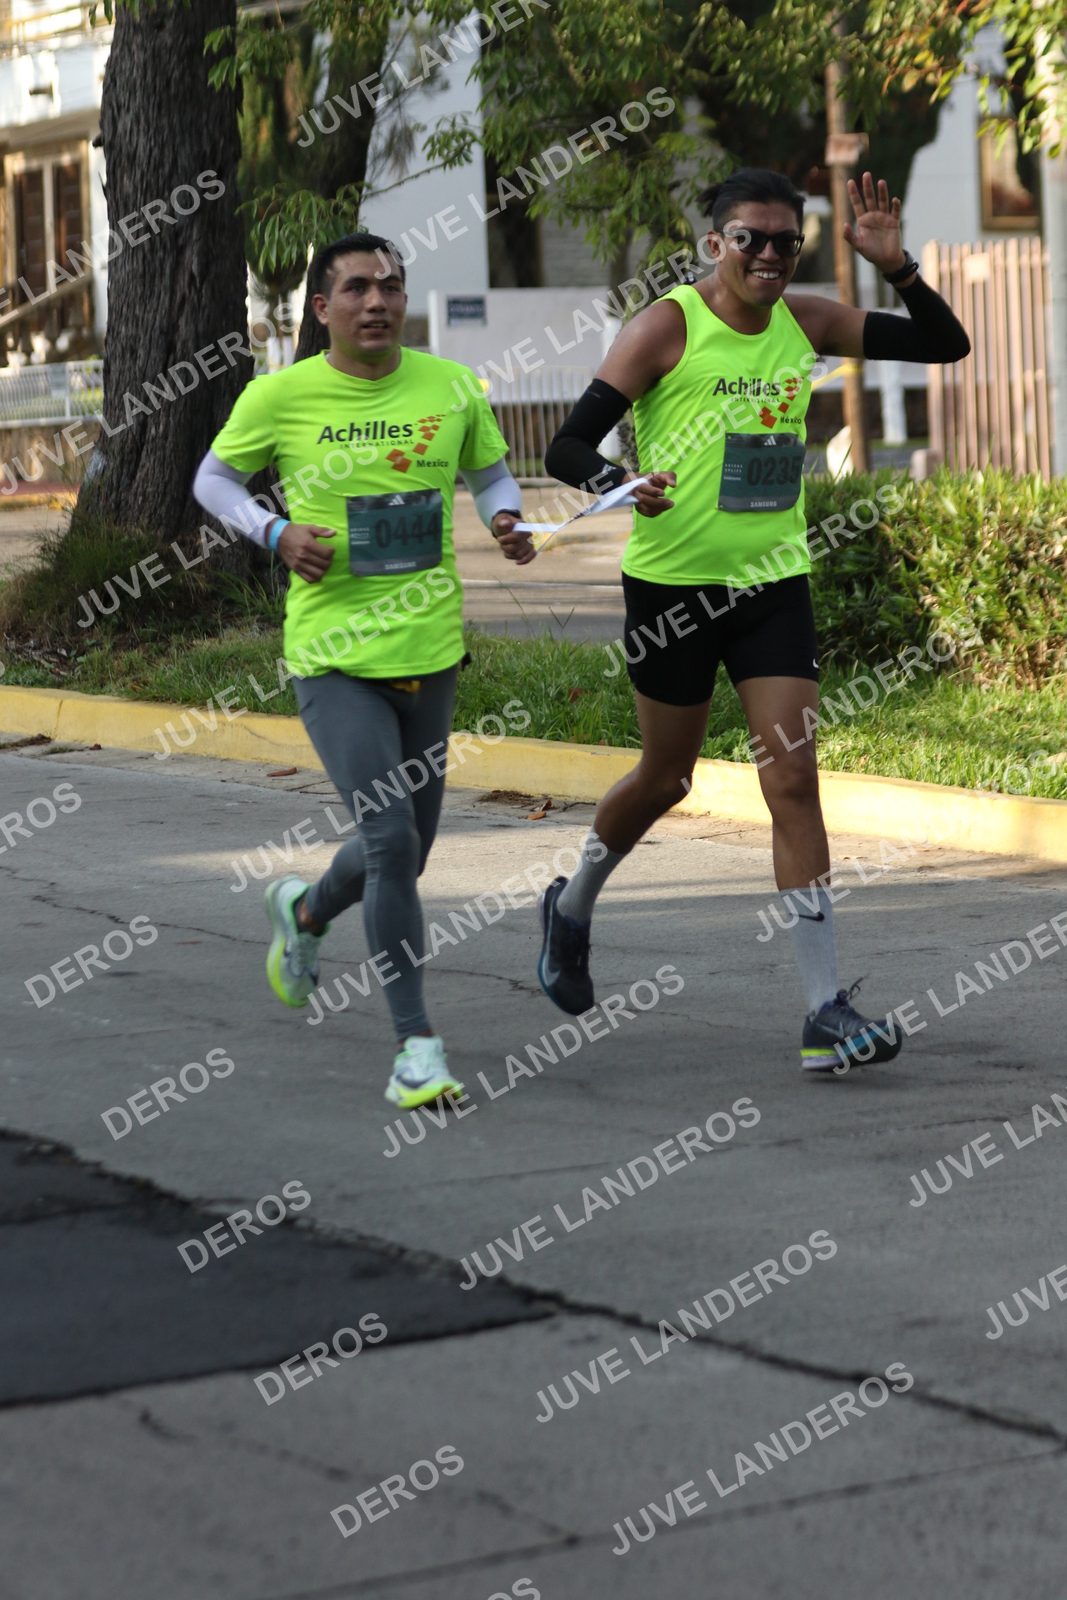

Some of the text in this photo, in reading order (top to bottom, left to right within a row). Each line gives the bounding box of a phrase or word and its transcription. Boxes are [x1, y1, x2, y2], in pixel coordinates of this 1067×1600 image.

[712, 376, 781, 396] Achilles
[316, 420, 414, 444] Achilles
[746, 455, 802, 486] 0235
[373, 511, 441, 549] 0444
